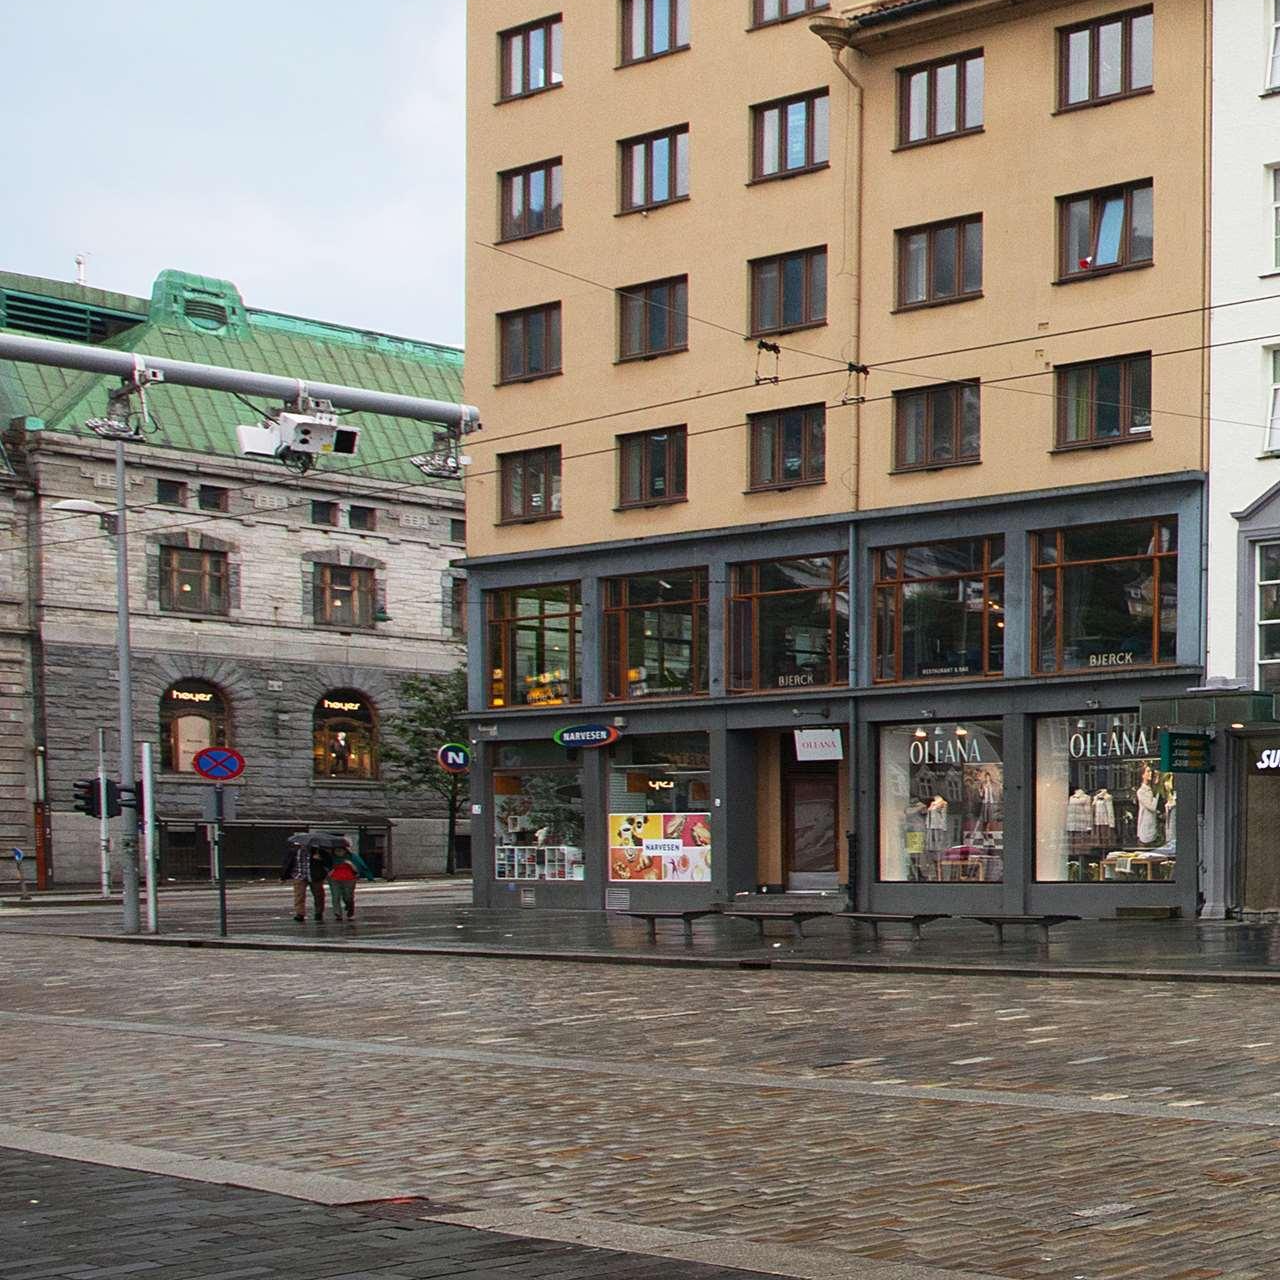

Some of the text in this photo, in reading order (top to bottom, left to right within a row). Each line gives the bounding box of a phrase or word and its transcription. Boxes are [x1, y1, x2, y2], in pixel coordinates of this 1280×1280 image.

[1089, 652, 1133, 666] BJERCK
[778, 673, 815, 687] BJERCK
[563, 730, 608, 742] NARVESEN
[910, 738, 982, 765] OLEANA
[1070, 730, 1149, 759] OLEANA
[447, 751, 464, 764] N
[645, 842, 680, 852] NARVESEN
